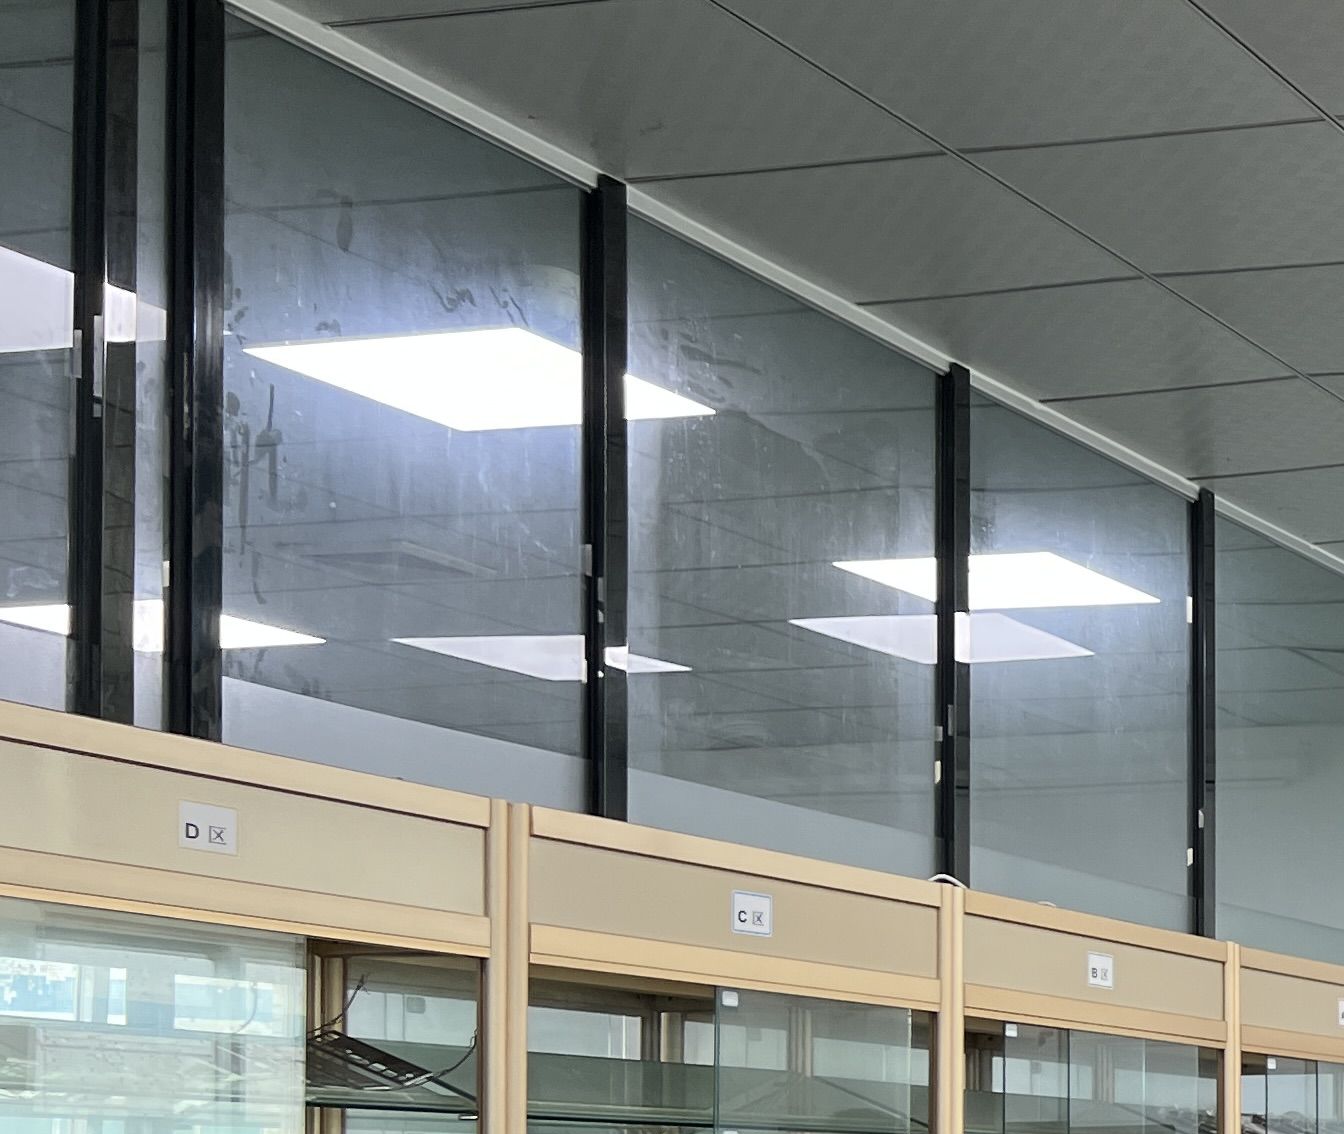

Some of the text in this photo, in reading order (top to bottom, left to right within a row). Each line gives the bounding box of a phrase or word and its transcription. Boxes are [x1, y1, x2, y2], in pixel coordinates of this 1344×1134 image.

[185, 822, 227, 845] D 区
[738, 910, 764, 926] C 区
